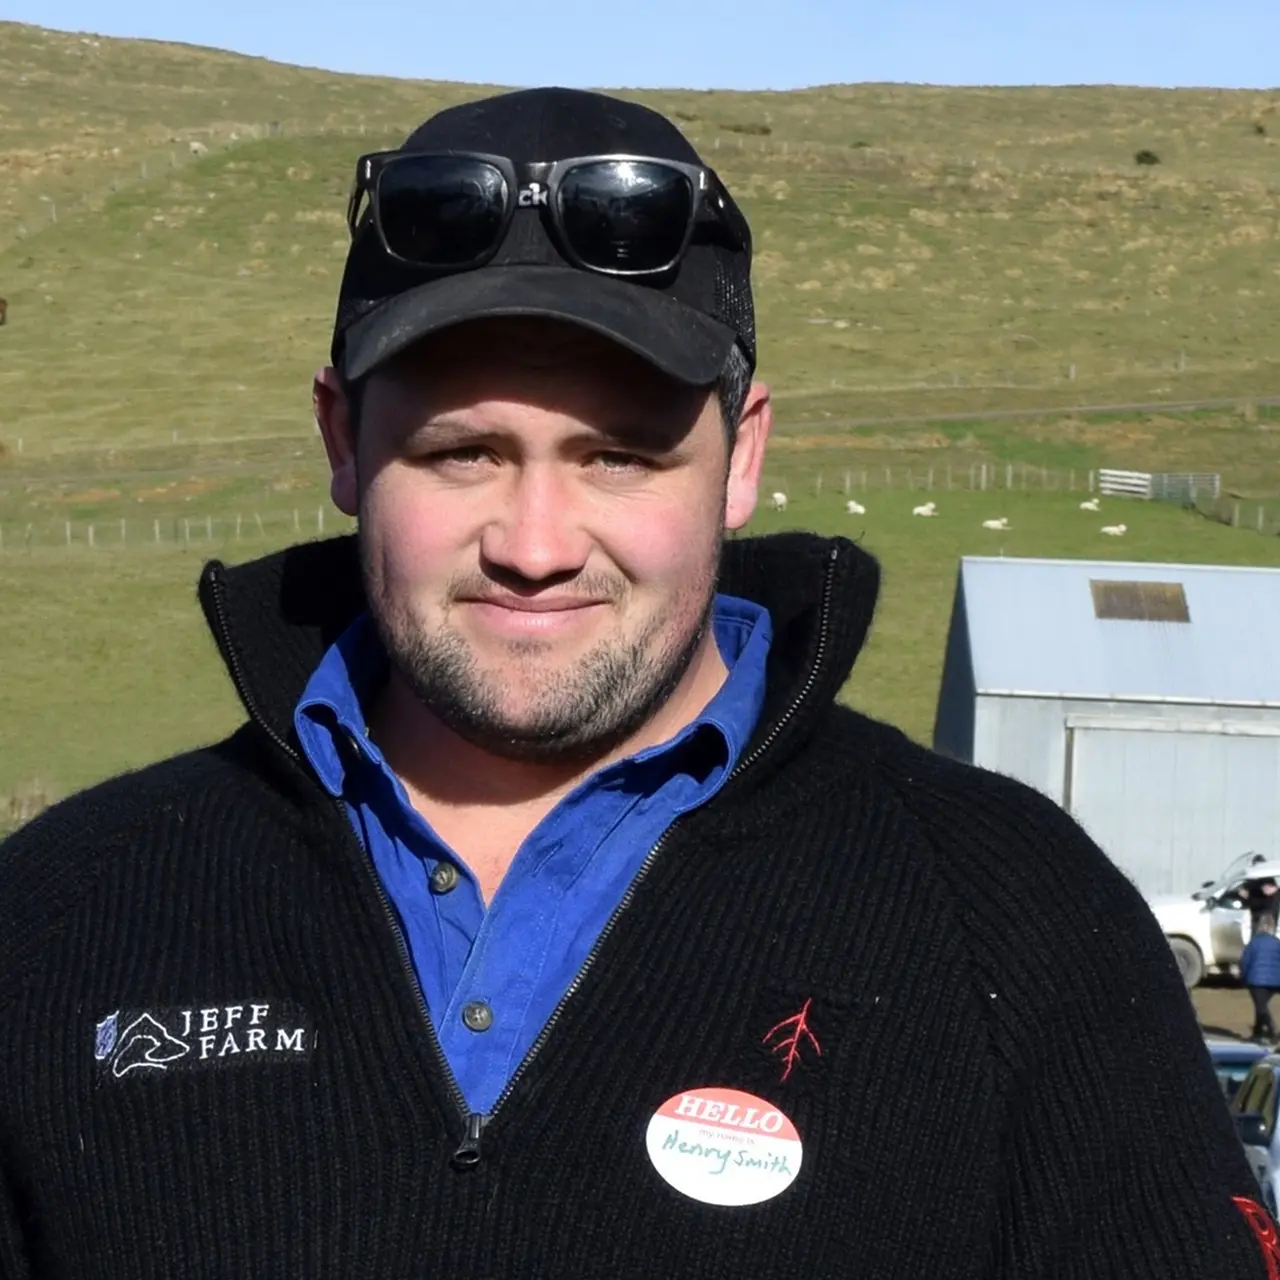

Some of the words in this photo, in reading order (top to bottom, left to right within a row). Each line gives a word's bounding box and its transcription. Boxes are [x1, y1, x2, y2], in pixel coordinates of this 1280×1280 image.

[181, 1004, 270, 1037] JEFF
[199, 1028, 305, 1060] FARM
[674, 1095, 784, 1133] HELLO
[662, 1129, 732, 1175] Henry
[733, 1150, 793, 1176] Smith
